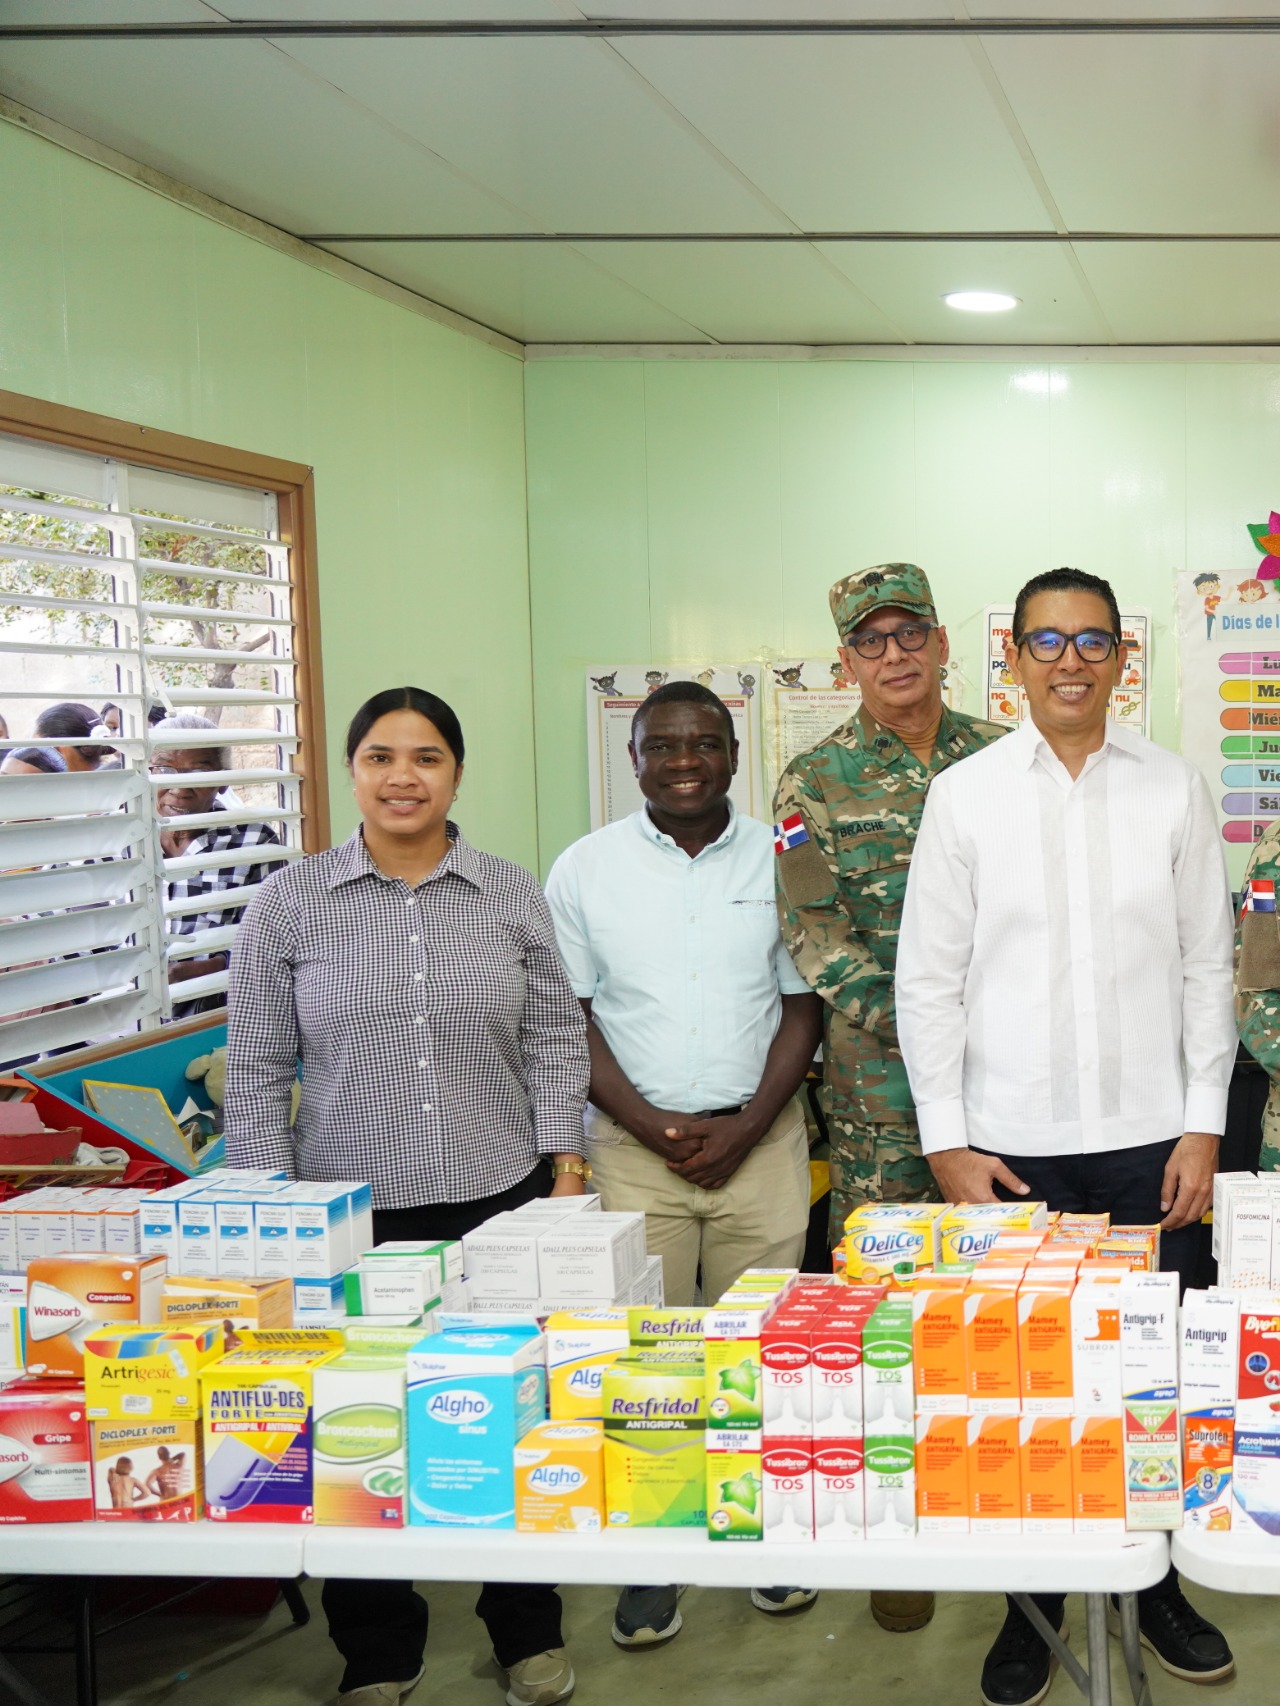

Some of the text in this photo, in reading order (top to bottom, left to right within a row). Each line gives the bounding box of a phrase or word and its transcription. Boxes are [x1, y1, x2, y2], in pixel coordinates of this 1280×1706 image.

[1222, 615, 1252, 630] Días
[1256, 615, 1272, 628] de
[992, 660, 1007, 670] pa
[991, 692, 1005, 700] na
[1116, 694, 1129, 702] nu
[840, 821, 885, 838] BRACHE
[861, 1232, 924, 1254] DeliCee
[88, 1294, 132, 1302] Congestión
[34, 1306, 81, 1317] Winasorb
[922, 1313, 952, 1323] Mamey
[974, 1316, 1004, 1326] Mamey
[1028, 1316, 1057, 1326] Mamey
[640, 1319, 704, 1338] Resfrid
[714, 1321, 747, 1329] ABRILAR
[1185, 1327, 1227, 1342] Antigrip
[656, 1341, 704, 1349] ANTIGRIPA
[765, 1352, 807, 1361] Tussibron
[815, 1352, 858, 1361] Tussibron
[866, 1351, 909, 1360] Tussibron
[101, 1364, 175, 1382] Artrigesic
[771, 1372, 803, 1384] TOS
[822, 1372, 853, 1384] TOS
[877, 1370, 902, 1381] TOS
[211, 1390, 305, 1409] ANTIFLU-DES
[431, 1396, 485, 1416] Algho
[612, 1398, 699, 1419] Resfridol
[210, 1409, 263, 1419] FORTE
[459, 1424, 487, 1434] sinus
[626, 1420, 687, 1429] ANTIGRIPAL
[100, 1425, 176, 1440] DICLOPLEX FORTE
[317, 1425, 398, 1438] Broncochem
[44, 1434, 72, 1445] Gripe
[926, 1435, 955, 1445] Mamey
[978, 1437, 1007, 1446] Mamey
[1030, 1437, 1059, 1446] Mamey
[1081, 1437, 1110, 1446] Mamey
[0, 1453, 28, 1462] asorb
[766, 1458, 808, 1467] Tussibron
[531, 1468, 581, 1486] Algho
[878, 1475, 903, 1486] TOS
[1203, 1473, 1213, 1489] 8
[772, 1478, 804, 1490] TOS
[824, 1478, 855, 1489] TOS
